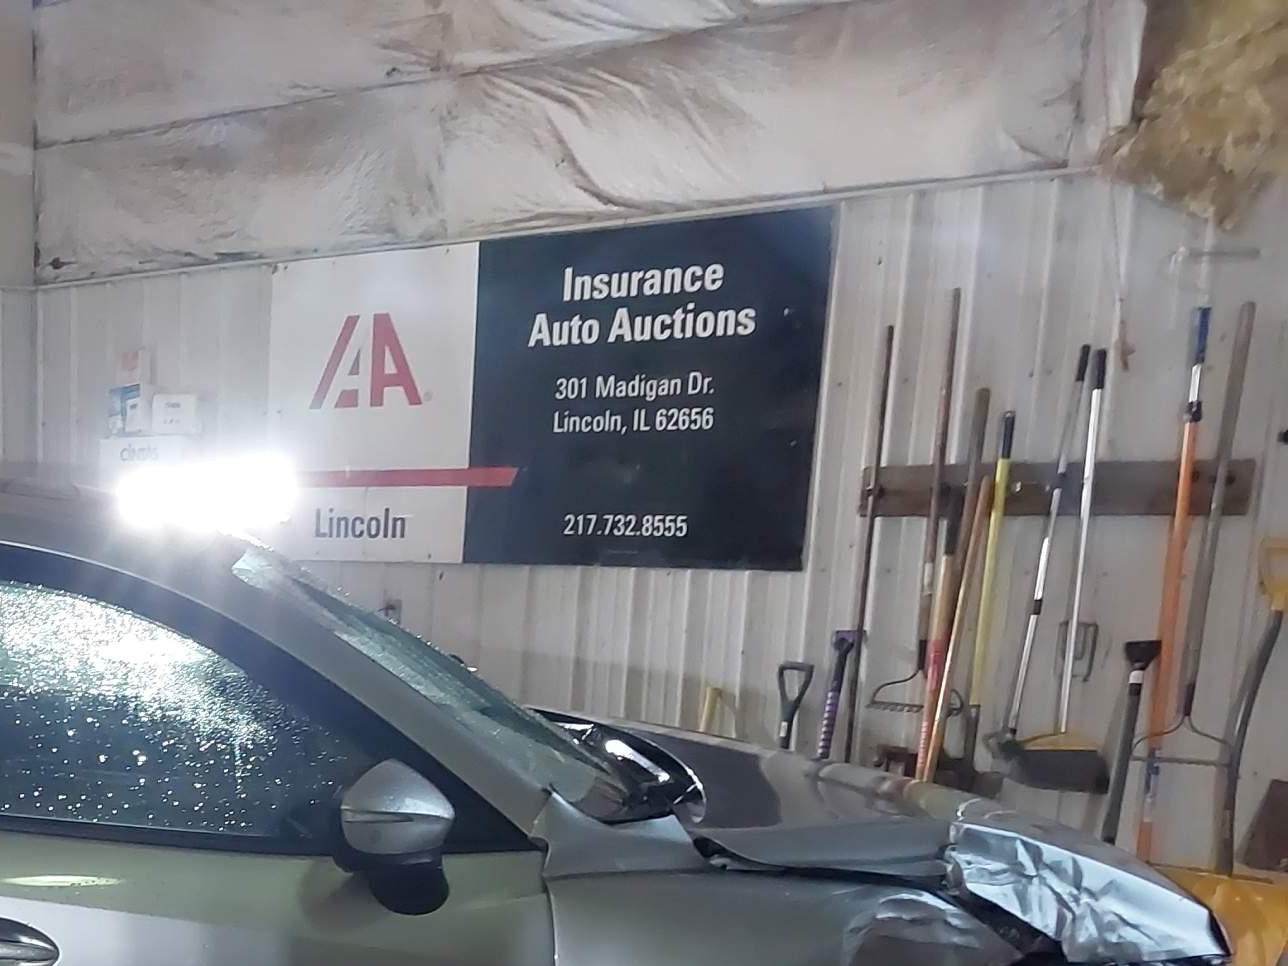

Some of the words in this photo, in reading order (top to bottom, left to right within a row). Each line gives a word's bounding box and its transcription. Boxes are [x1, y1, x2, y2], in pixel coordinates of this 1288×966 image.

[562, 263, 724, 301] Insurance
[528, 312, 600, 347] Auto
[608, 302, 756, 342] Auctions
[555, 377, 587, 400] 301
[595, 374, 681, 402] Madigan
[687, 371, 715, 395] Dr.
[553, 410, 627, 435] Lincoln,
[632, 409, 651, 431] IL
[655, 407, 714, 431] 62656
[314, 508, 406, 540] Lincoln
[563, 513, 688, 538] 217.732.8555
